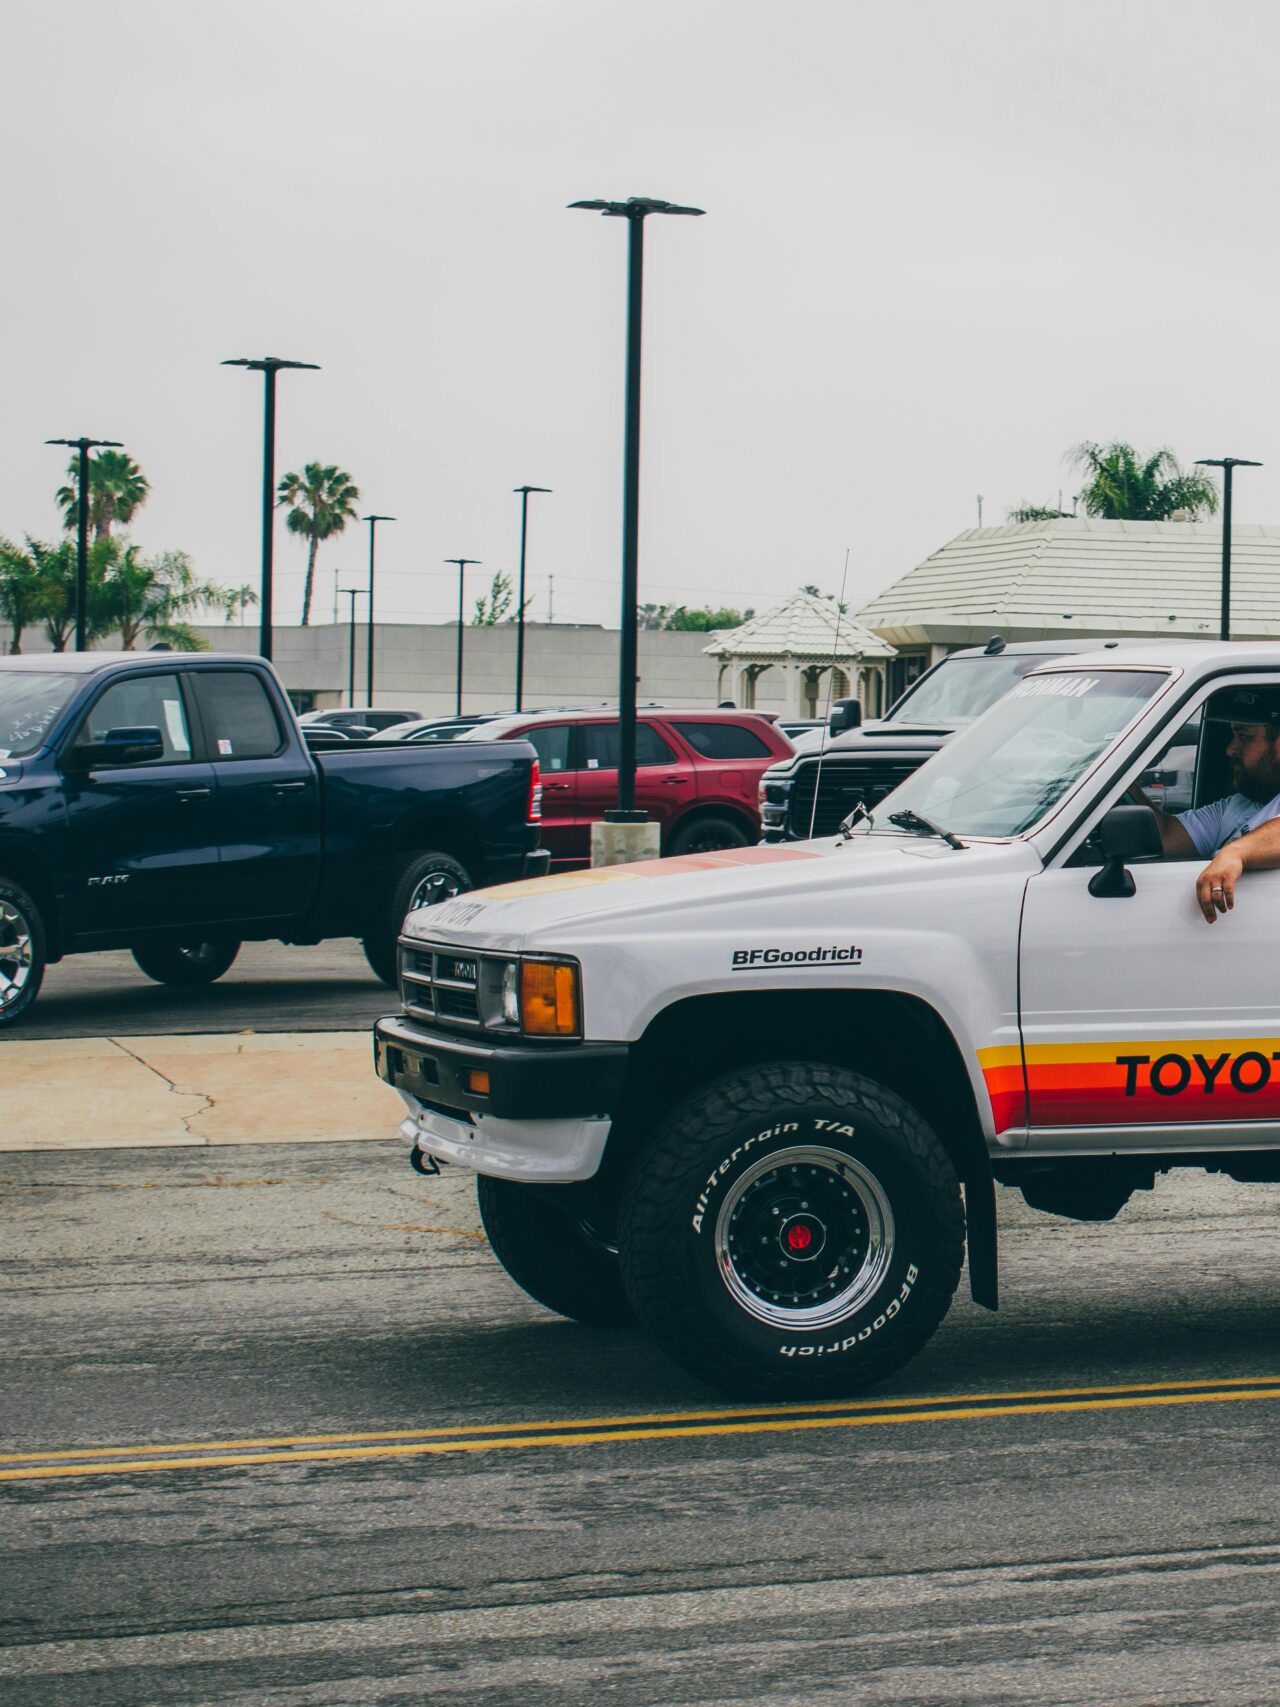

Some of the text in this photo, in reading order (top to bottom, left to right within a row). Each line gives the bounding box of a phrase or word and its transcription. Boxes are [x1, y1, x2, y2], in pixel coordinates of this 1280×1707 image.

[732, 945, 863, 965] BFGoodrich
[691, 1118, 856, 1234] All-Terrain T/A
[778, 1263, 920, 1357] BFGoodrich
